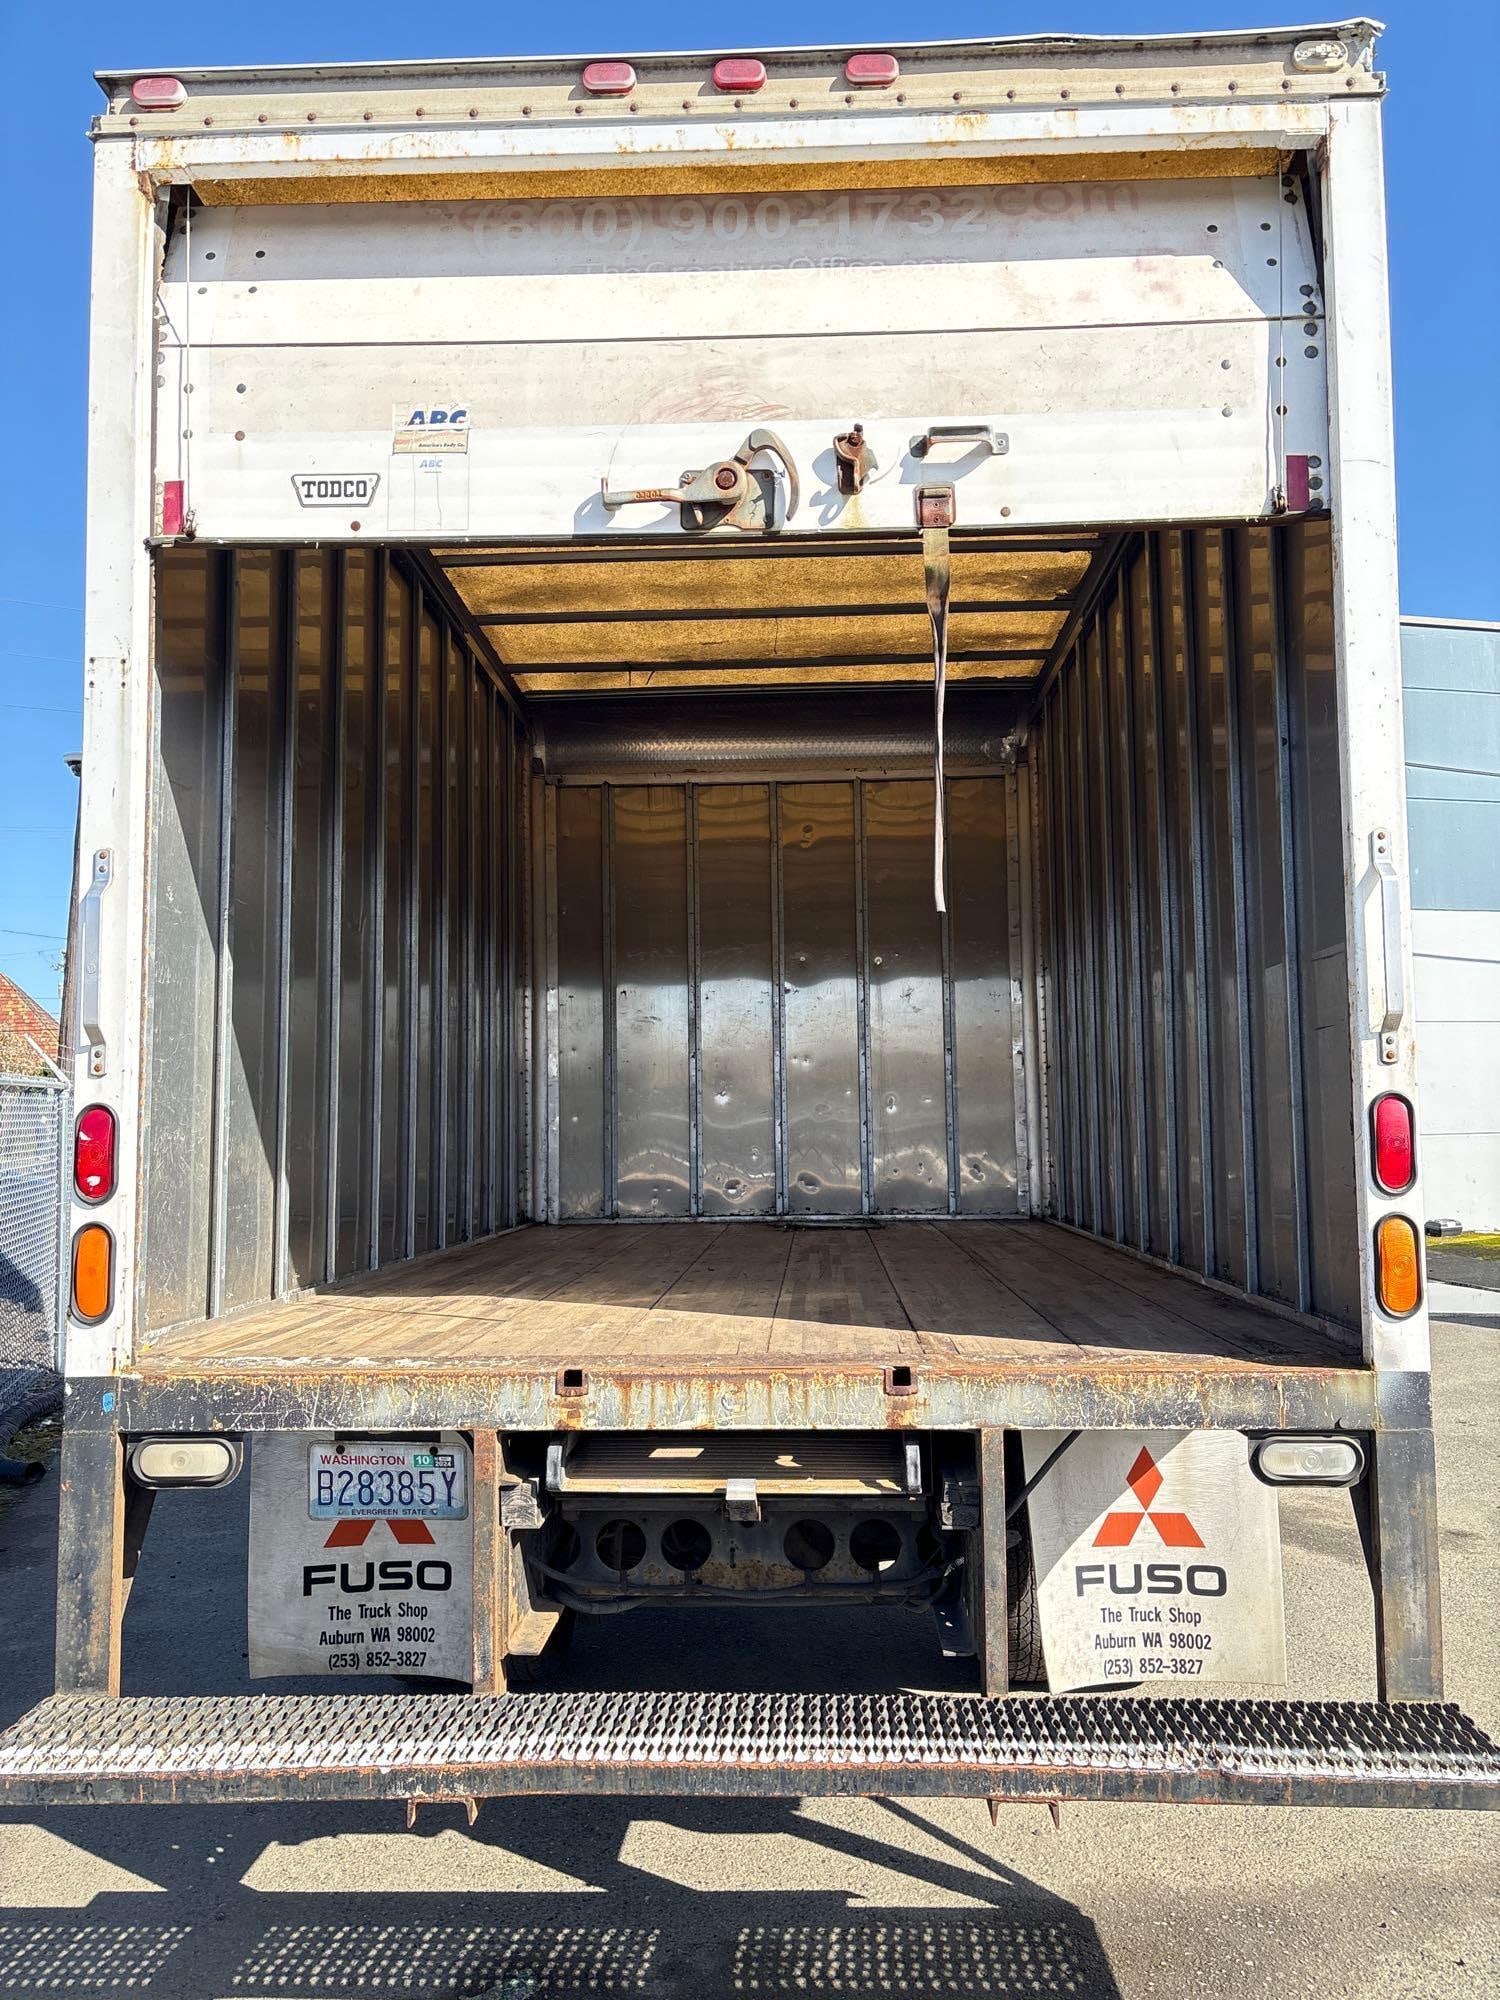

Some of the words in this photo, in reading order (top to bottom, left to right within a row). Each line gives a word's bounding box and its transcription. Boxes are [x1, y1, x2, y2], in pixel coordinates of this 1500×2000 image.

[670, 191, 990, 243] 900-1732
[419, 459, 443, 468] ABC
[301, 480, 367, 498] TODCO
[320, 1455, 405, 1465] WASHINGTON
[415, 1455, 430, 1465] 10
[318, 1470, 457, 1507] B28385Y
[303, 1560, 452, 1596] FUSO
[1075, 1563, 1227, 1597] FUSO
[328, 1606, 351, 1621] The
[358, 1602, 391, 1619] Truck
[398, 1602, 428, 1620] Shop
[1100, 1608, 1122, 1623] The
[1128, 1606, 1162, 1622] Truck
[1169, 1607, 1201, 1627] Shop
[319, 1630, 364, 1645] Auburn
[371, 1627, 390, 1642] WA
[397, 1627, 435, 1642] 98002
[1095, 1633, 1136, 1649] Auburn
[1142, 1632, 1163, 1648] WA
[1169, 1633, 1212, 1650] 98002
[328, 1653, 360, 1670] (253)
[366, 1651, 427, 1667] 852-3827
[1104, 1659, 1133, 1678] (253)
[1139, 1658, 1203, 1674] 852-3827
